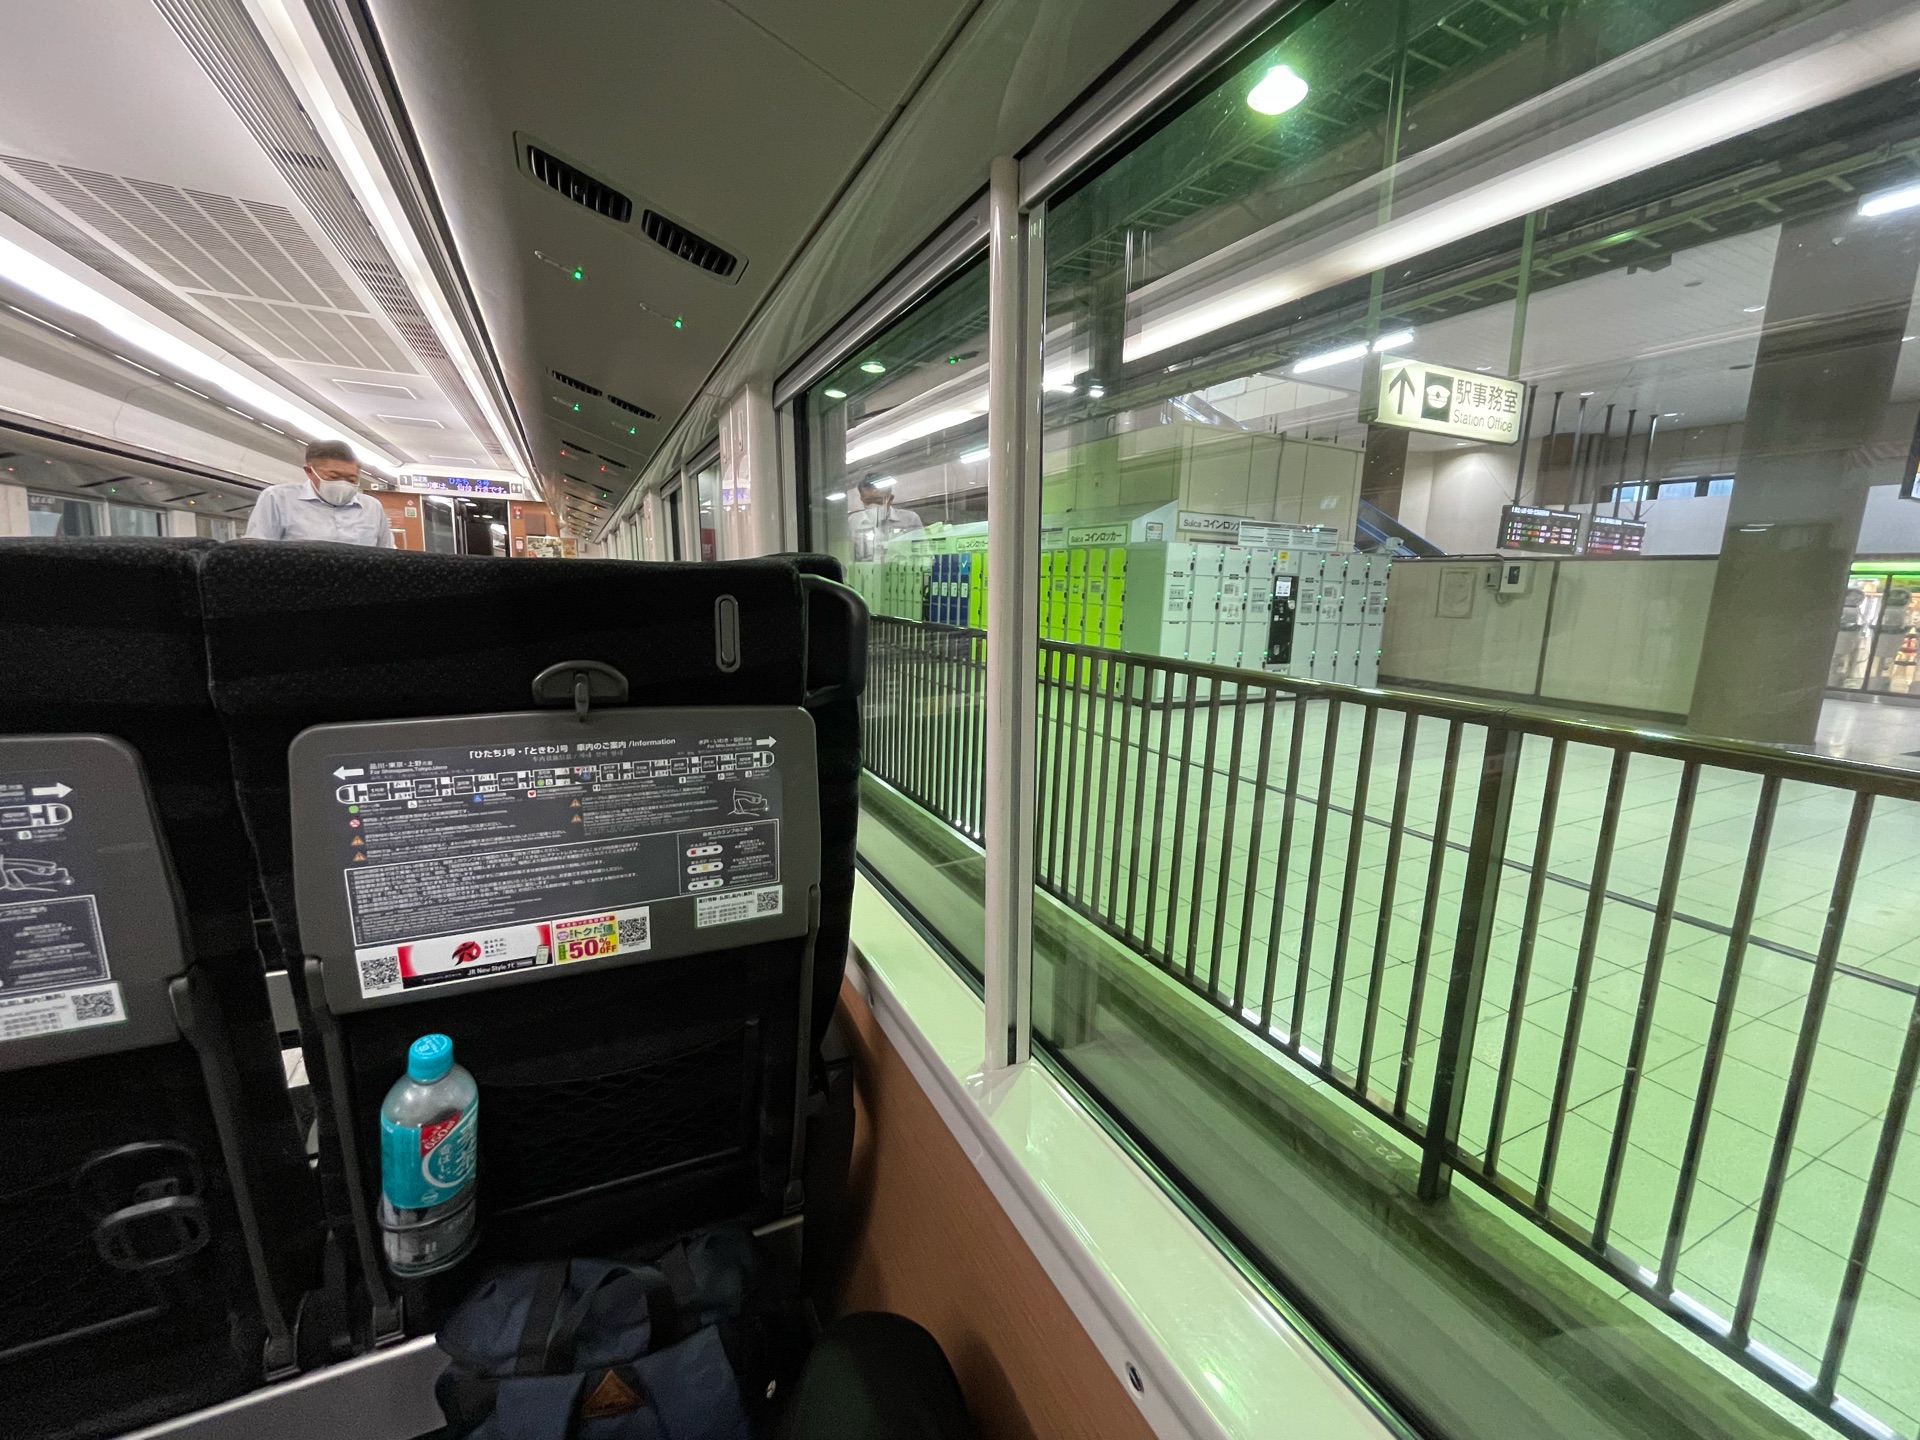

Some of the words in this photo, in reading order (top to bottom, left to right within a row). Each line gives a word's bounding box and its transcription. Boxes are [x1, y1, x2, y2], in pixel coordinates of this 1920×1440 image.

[1455, 378, 1519, 415] 駅事務室
[1452, 411, 1485, 429] Station
[1487, 414, 1513, 434] Office
[402, 476, 408, 485] 1
[1183, 519, 1201, 528] Suica
[1070, 535, 1084, 543] Suica
[1084, 531, 1122, 542] コインロッカー
[628, 737, 676, 748] /Information
[600, 944, 617, 954] OFF
[491, 964, 507, 972] Style
